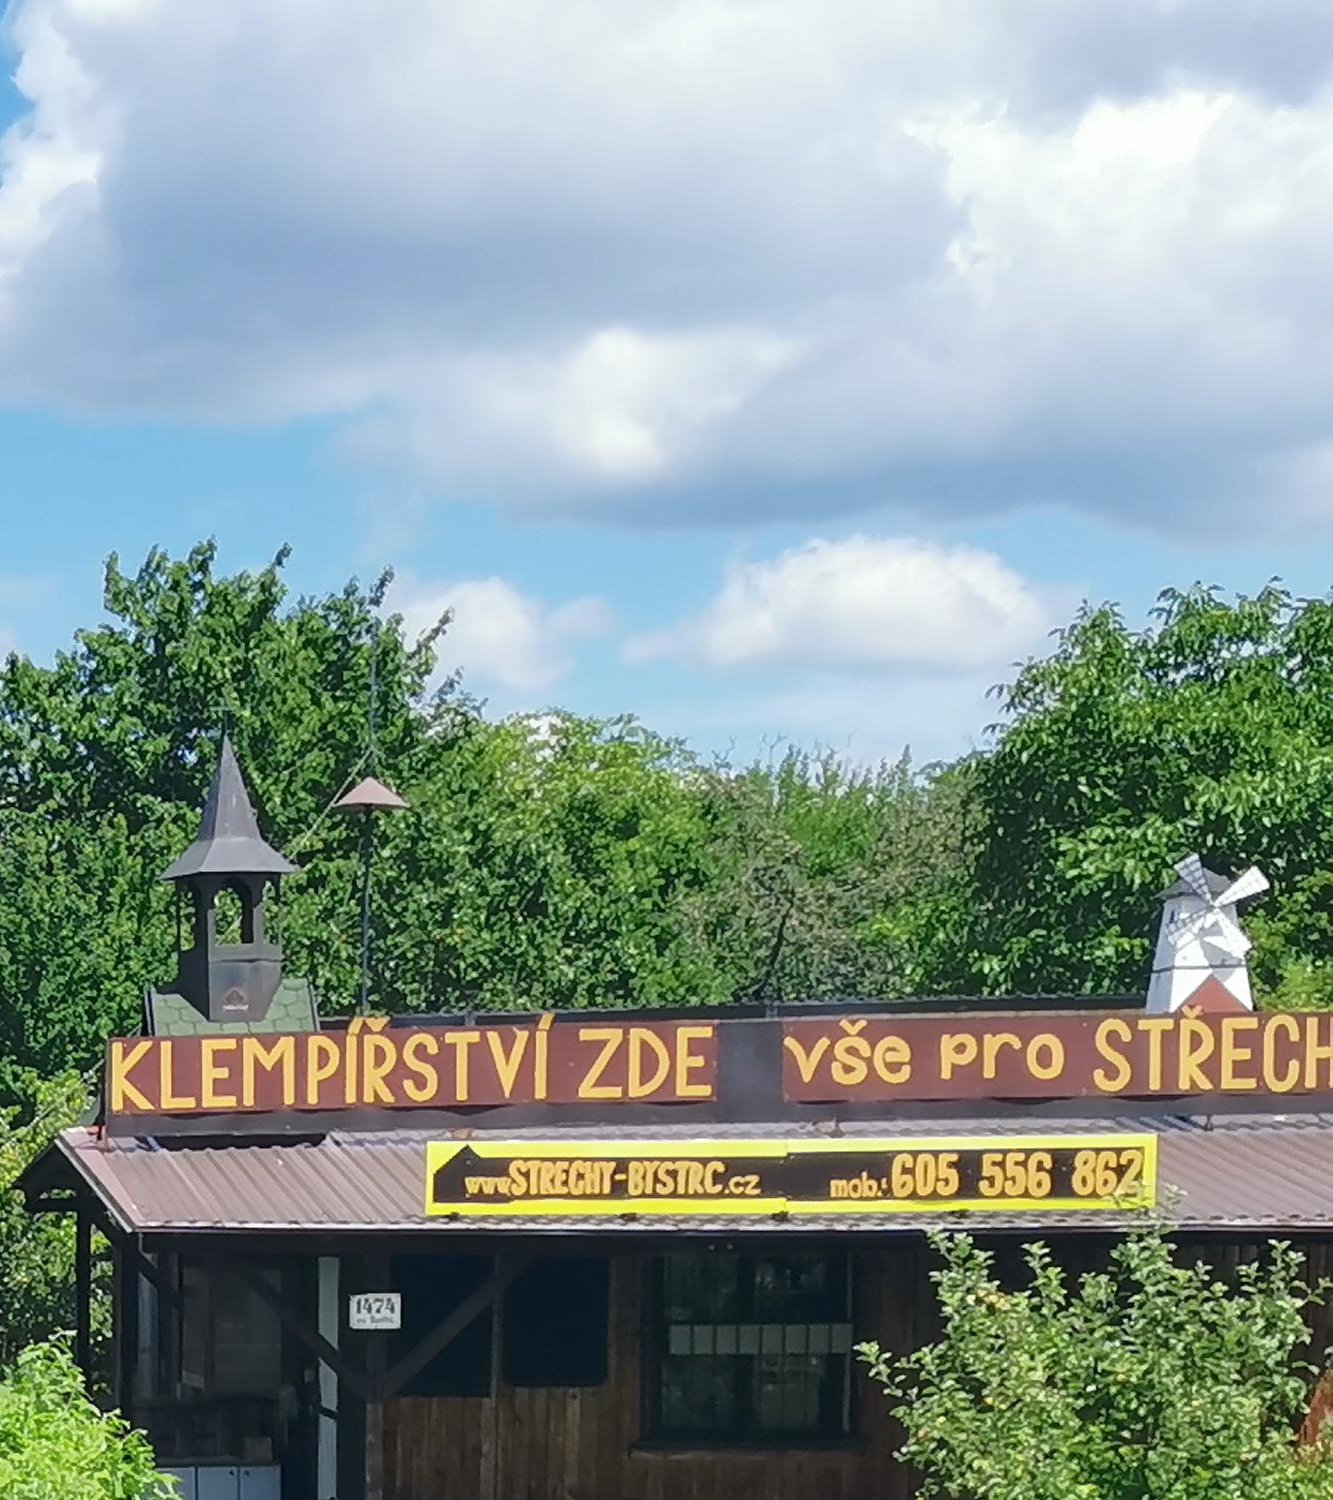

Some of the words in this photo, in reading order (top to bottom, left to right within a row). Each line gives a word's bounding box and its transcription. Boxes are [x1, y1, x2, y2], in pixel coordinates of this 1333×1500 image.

[112, 1012, 554, 1112] KLEMPÍŘSTVÍ
[579, 1026, 713, 1098] ZDE
[784, 1019, 911, 1084] vše
[940, 1033, 1065, 1079] pro
[892, 1153, 959, 1197] 605
[978, 1151, 1053, 1198] 556
[357, 1298, 396, 1314] 1474
